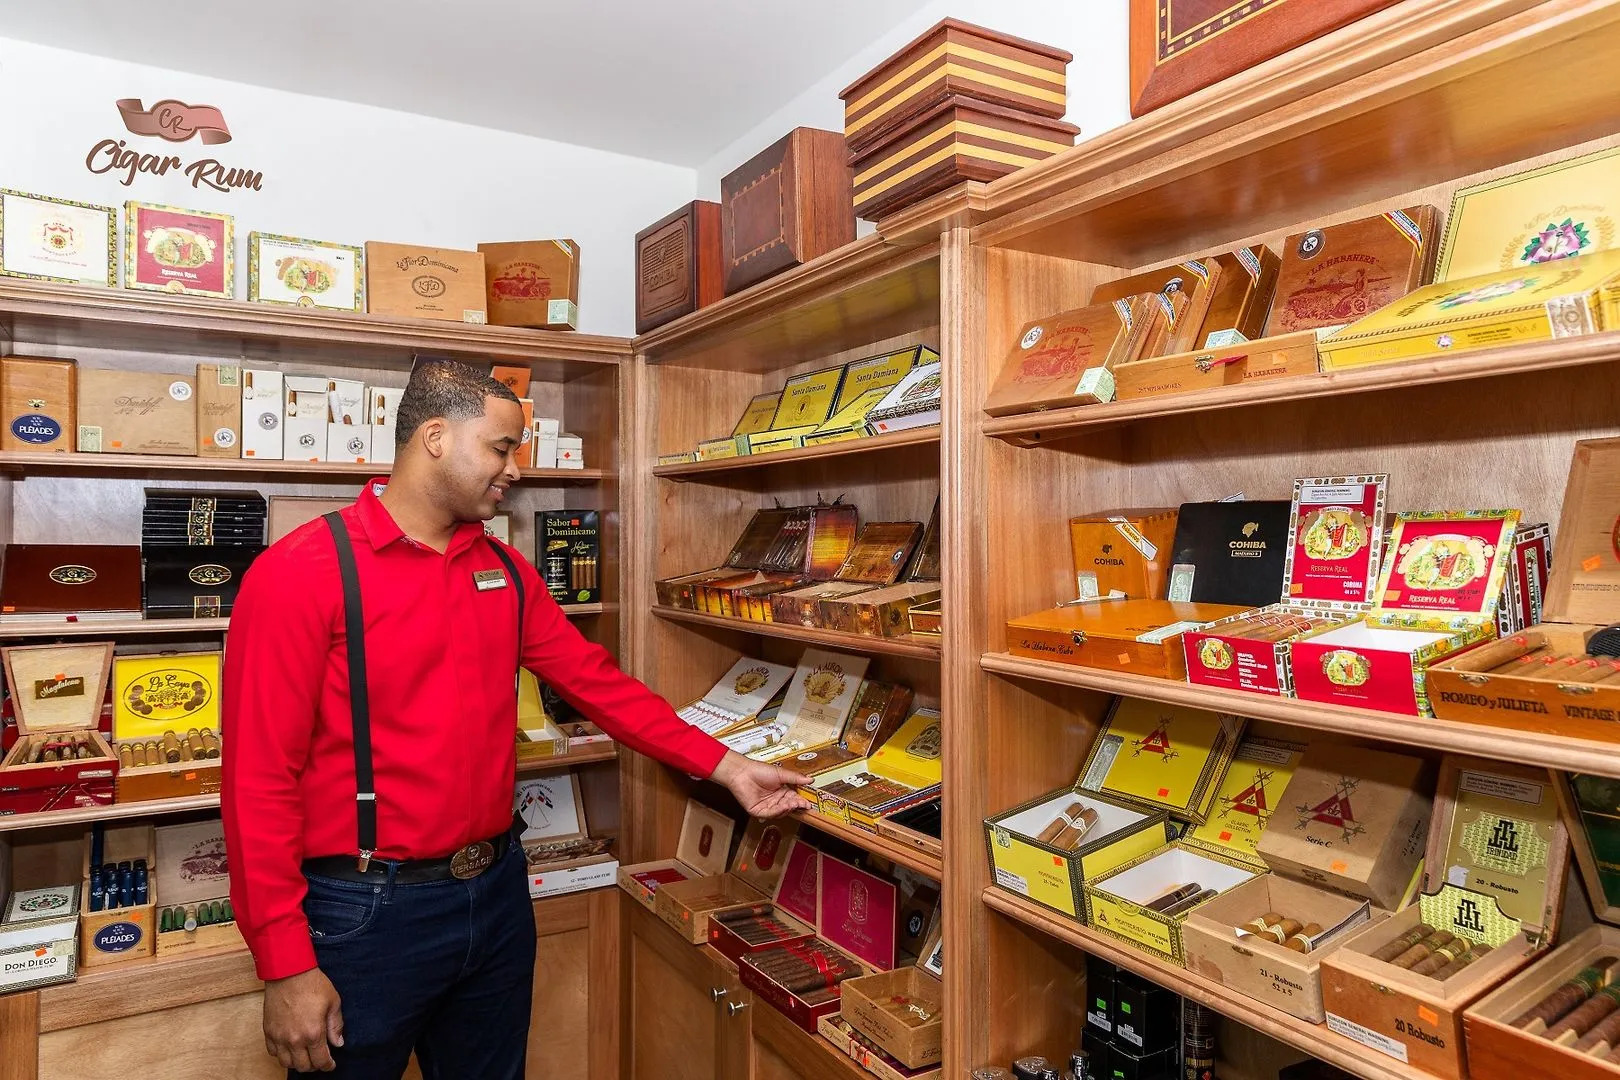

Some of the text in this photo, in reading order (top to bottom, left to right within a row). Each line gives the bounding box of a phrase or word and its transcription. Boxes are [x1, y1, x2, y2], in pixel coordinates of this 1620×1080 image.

[158, 108, 192, 134] CR
[85, 139, 263, 193] Cigar Rum
[856, 367, 899, 383] Santa Damiana
[791, 383, 827, 397] Santa Damiana
[546, 518, 571, 527] Sabor
[547, 527, 596, 537] Dominicano
[1228, 541, 1267, 549] COHIBA
[1094, 558, 1125, 566] COHIBA
[1343, 581, 1363, 589] CORONA
[1409, 594, 1456, 605] RESERVA REAL
[145, 674, 191, 693] La Caya
[1440, 691, 1488, 708] ROMEO
[1496, 697, 1550, 714] JULIETA
[1563, 704, 1614, 722] VINTAGE
[1305, 835, 1333, 849] Serie C
[1486, 846, 1518, 861] TRINIDAD
[1476, 878, 1485, 886] 20
[1490, 881, 1519, 896] Robusto
[1453, 925, 1486, 942] TRINIDAD
[4, 962, 26, 971] DON
[28, 957, 58, 967] DIEGO
[1259, 968, 1268, 977] 21
[1274, 973, 1304, 991] Robusto
[1272, 982, 1281, 992] 52
[1394, 1018, 1405, 1033] 20
[1406, 1022, 1446, 1049] Robusto
